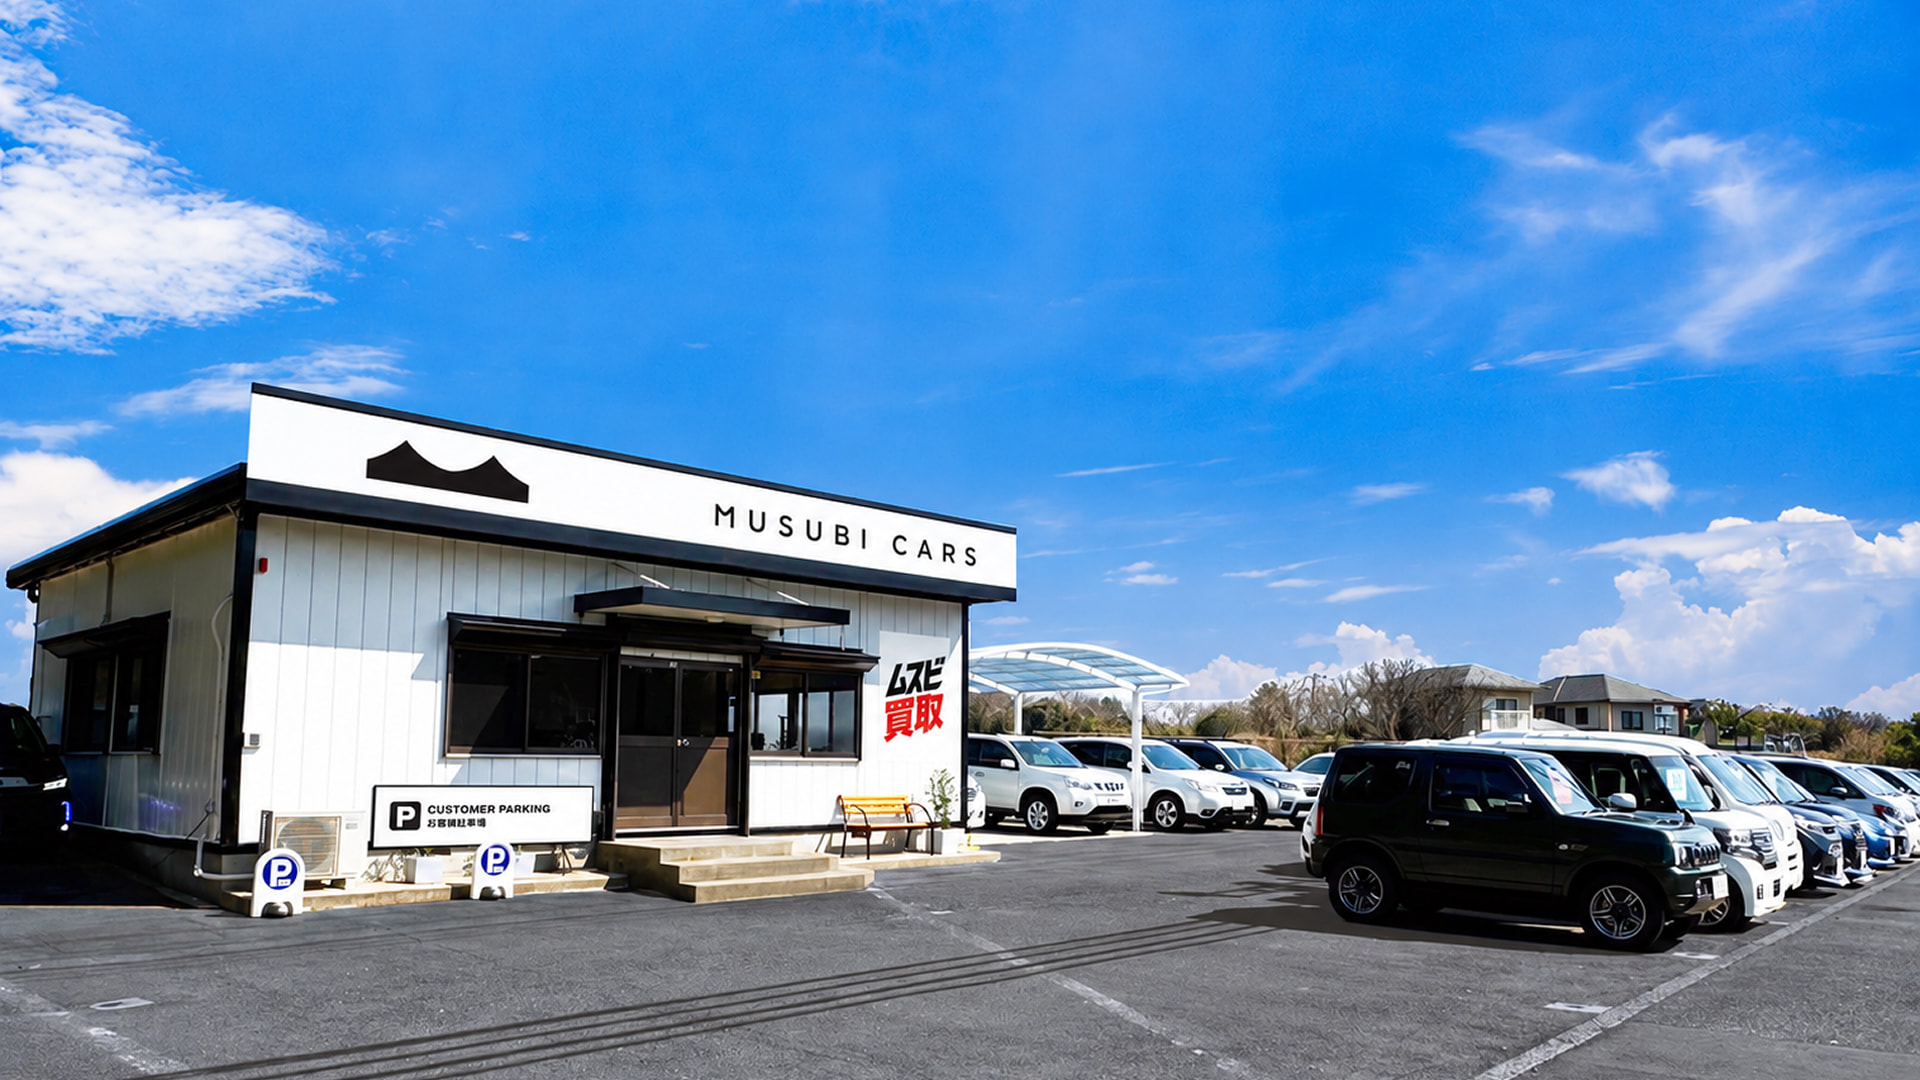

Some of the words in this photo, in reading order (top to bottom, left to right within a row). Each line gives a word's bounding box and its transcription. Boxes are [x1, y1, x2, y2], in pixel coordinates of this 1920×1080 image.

[714, 503, 867, 549] MUSUBI
[892, 534, 977, 567] CARS
[885, 656, 946, 697] ムスビ
[884, 693, 944, 743] 買取
[397, 805, 416, 828] P
[427, 804, 496, 815] CUSTOMER
[499, 804, 551, 814] PARKING
